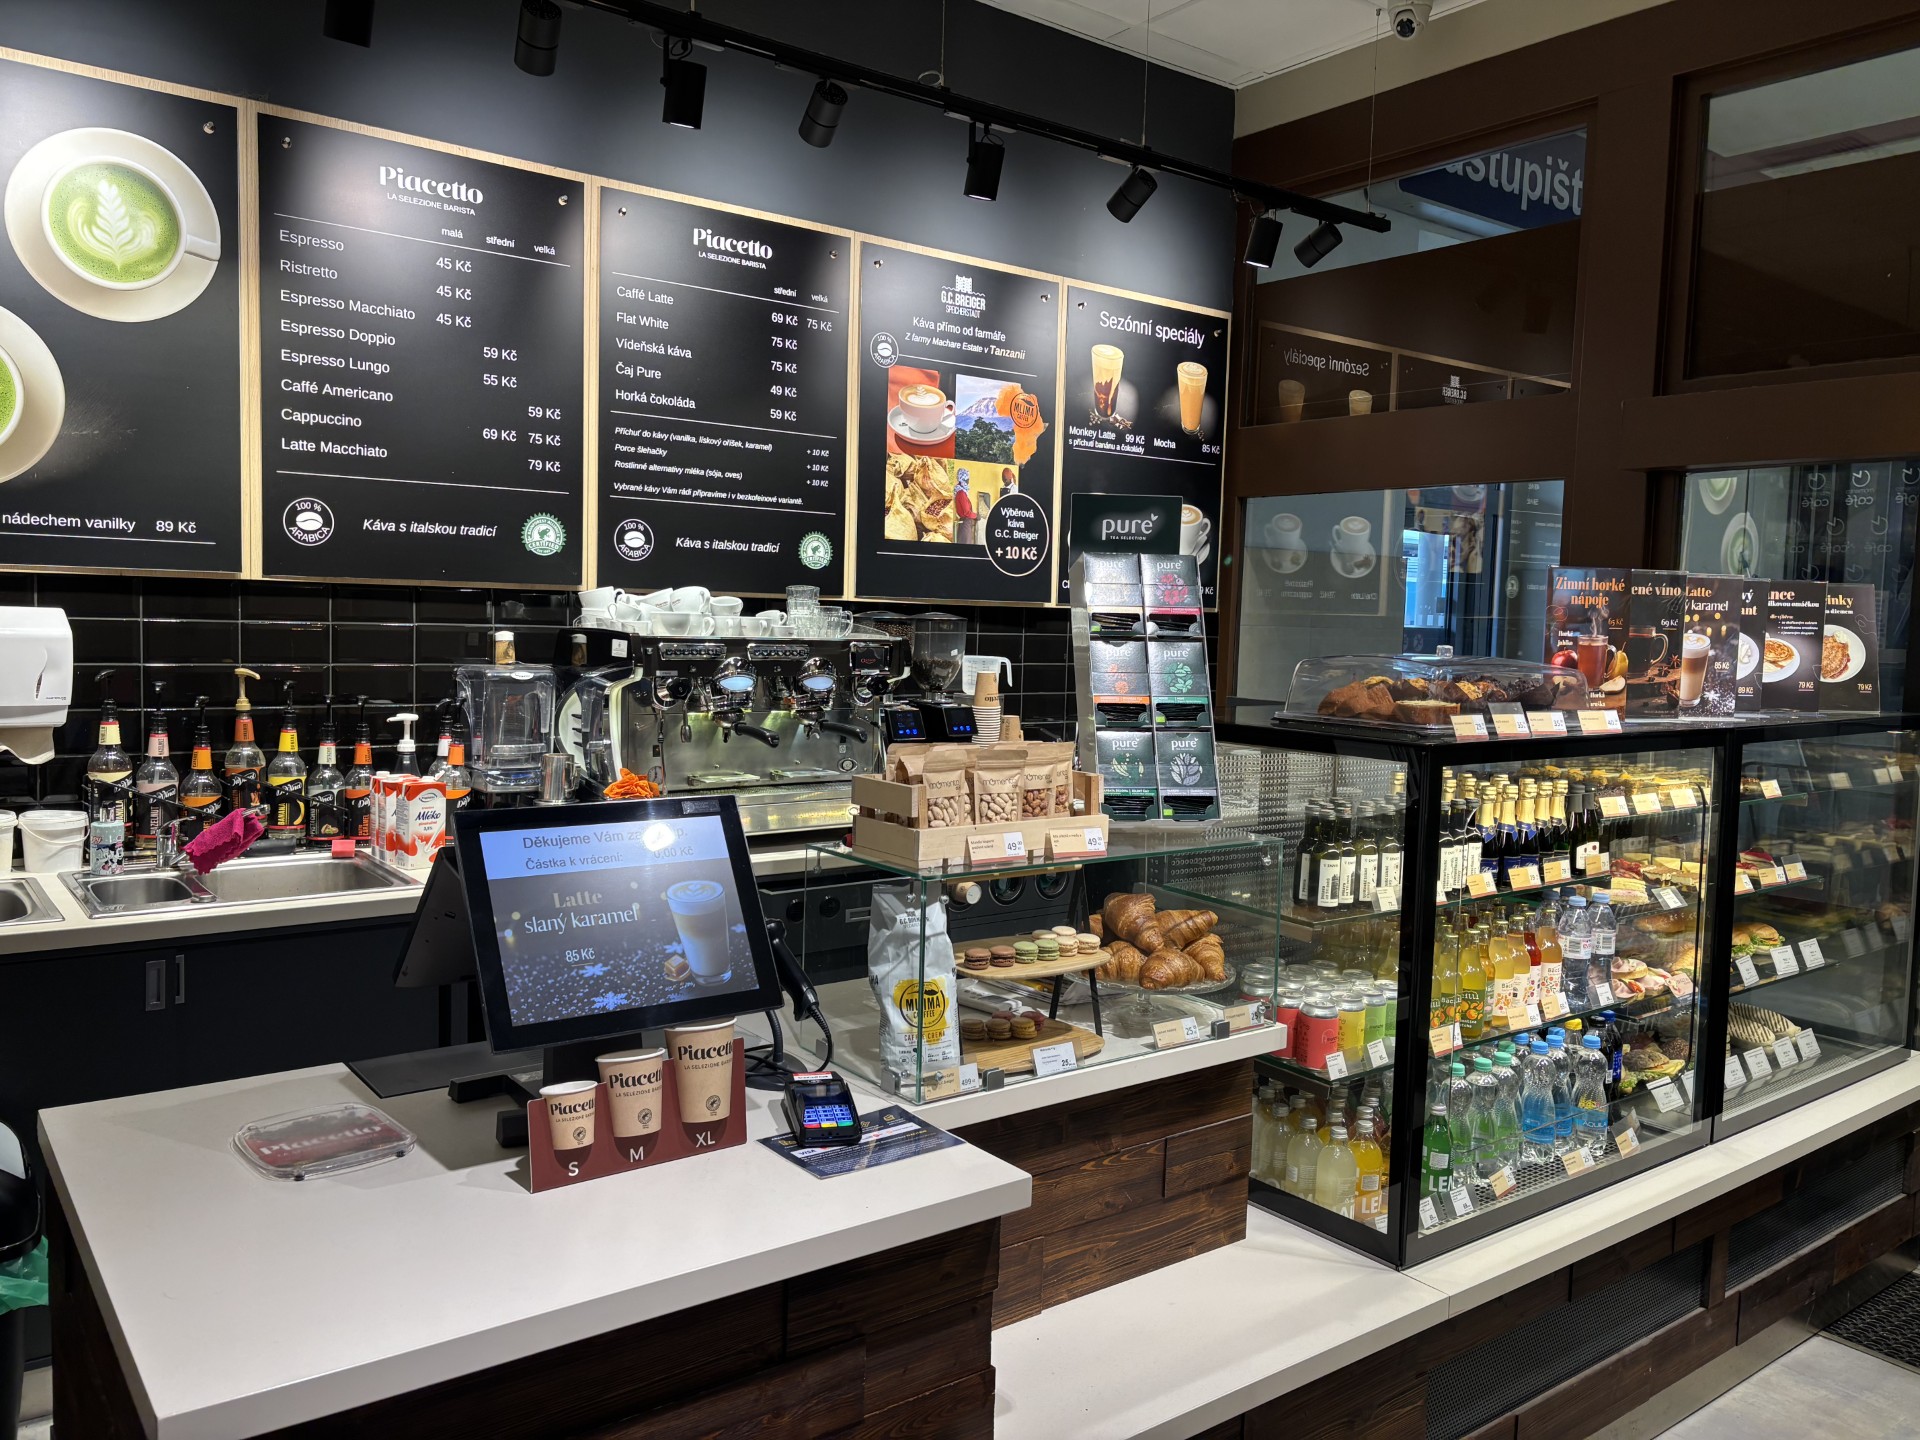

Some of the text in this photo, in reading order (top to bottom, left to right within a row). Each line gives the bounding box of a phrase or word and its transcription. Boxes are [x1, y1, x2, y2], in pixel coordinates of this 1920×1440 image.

[379, 165, 483, 204] Piacetto
[387, 192, 476, 216] LA SELEZIONE BARISTA
[279, 230, 345, 252] Espresso
[441, 227, 556, 255] malá střední velká
[693, 228, 773, 260] Piacetto
[280, 259, 338, 280] Ristretto
[436, 257, 472, 273] 45 Kč
[616, 286, 674, 305] Caffé Latte
[774, 286, 828, 303] střední velká
[280, 289, 416, 320] Espresso Macchiato
[616, 312, 669, 330] Flat White
[771, 312, 799, 326] 69 Kč
[806, 318, 832, 332] 75 Kč
[280, 319, 396, 346] Espresso Doppio
[913, 316, 1006, 342] Káva přímo od farmáře
[1100, 311, 1205, 349] Sezónní speciály
[615, 338, 692, 358] Vídeňská káva
[905, 333, 911, 341] Z
[911, 333, 931, 346] farmy
[932, 337, 961, 349] Machare
[962, 343, 983, 353] Estate
[990, 345, 1026, 360] Tanzanii
[281, 349, 390, 374] Espresso Lungo
[615, 361, 662, 379] Čaj Pure
[281, 379, 393, 402] Caffé Americano
[615, 389, 696, 409] Horká čokoláda
[281, 408, 362, 428] Cappuccino
[482, 428, 517, 442] 69 Kč
[528, 433, 561, 447] 75 Kč
[642, 430, 651, 438] do
[652, 430, 669, 441] kávy
[669, 431, 697, 444] (vanilka,
[699, 435, 722, 447] lískový
[745, 441, 773, 453] karamel)
[1069, 426, 1116, 440] Monkey Latte
[1125, 434, 1145, 445] 99 Kč
[281, 438, 388, 458] Latte Macchiato
[614, 444, 667, 457] Porce šlehačky
[1153, 437, 1176, 449] Mocha
[1202, 444, 1220, 455] 85 Kč
[614, 460, 743, 480] Rostlinné alternativy mléka (sója, oves)
[1001, 507, 1034, 519] Výběrová
[2, 512, 136, 533] nádechem vanilky
[155, 520, 197, 533] 89 Kč
[363, 518, 497, 537] Káva s italskou tradicí
[1007, 518, 1025, 529] káva
[1101, 518, 1154, 541] pure
[288, 525, 331, 543] ARABICA
[995, 529, 1039, 541] G.C. Breiger
[675, 537, 780, 553] Káva s italskou tradicí
[995, 546, 1038, 561] + 10 Kč
[1157, 561, 1182, 572] pure
[1555, 577, 1626, 592] Zimní horké
[1655, 583, 1681, 596] víno
[1686, 586, 1712, 598] Latte
[1570, 593, 1609, 608] nápoje
[1691, 601, 1729, 612] karamel
[1661, 618, 1678, 627] 69 Kč
[1722, 662, 1730, 670] Kč
[1806, 682, 1814, 690] Kč
[1171, 740, 1197, 750] pure
[278, 803, 286, 825] BANANA
[415, 810, 441, 821] Mléko
[523, 832, 591, 849] Děkujeme
[593, 830, 624, 843] Vám
[1007, 842, 1017, 851] 49
[525, 853, 624, 870] Částka k vrácení:
[552, 890, 603, 909] Latte
[524, 904, 639, 934] slaný karamel
[566, 948, 596, 963] 85 Kč
[1185, 1028, 1194, 1036] 25
[695, 1131, 716, 1148] XL
[629, 1146, 644, 1163] M
[568, 1161, 579, 1177] S
